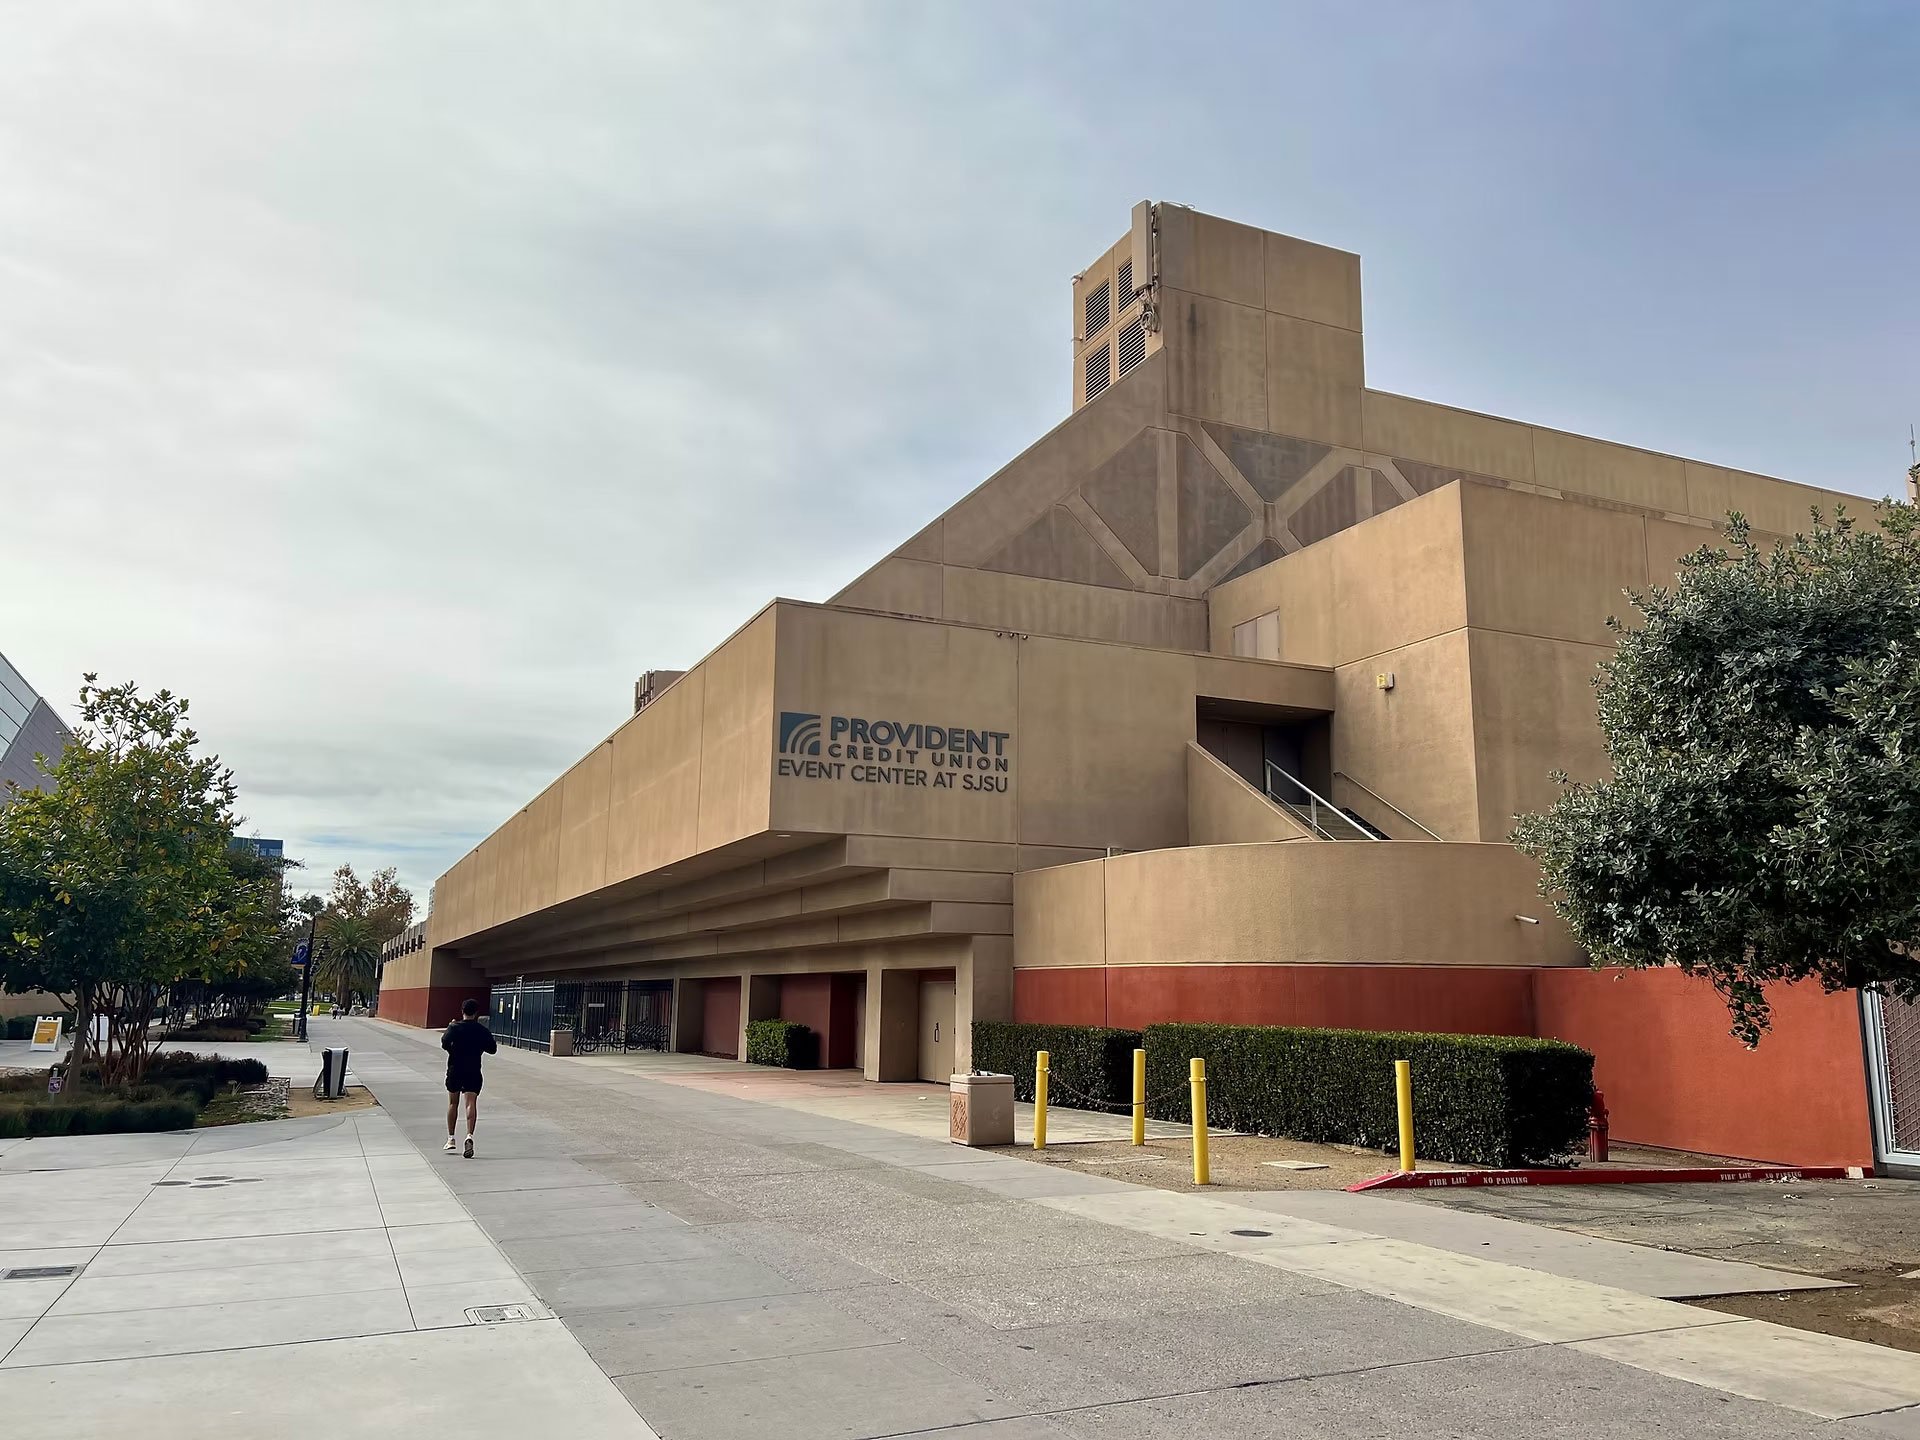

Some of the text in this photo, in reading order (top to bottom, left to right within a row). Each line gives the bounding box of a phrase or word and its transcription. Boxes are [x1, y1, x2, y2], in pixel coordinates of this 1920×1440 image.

[830, 716, 1010, 756] PROVIDENT
[828, 744, 1008, 772] CREDIT UNION
[778, 759, 1008, 793] EVENT CENTER AT SJSU
